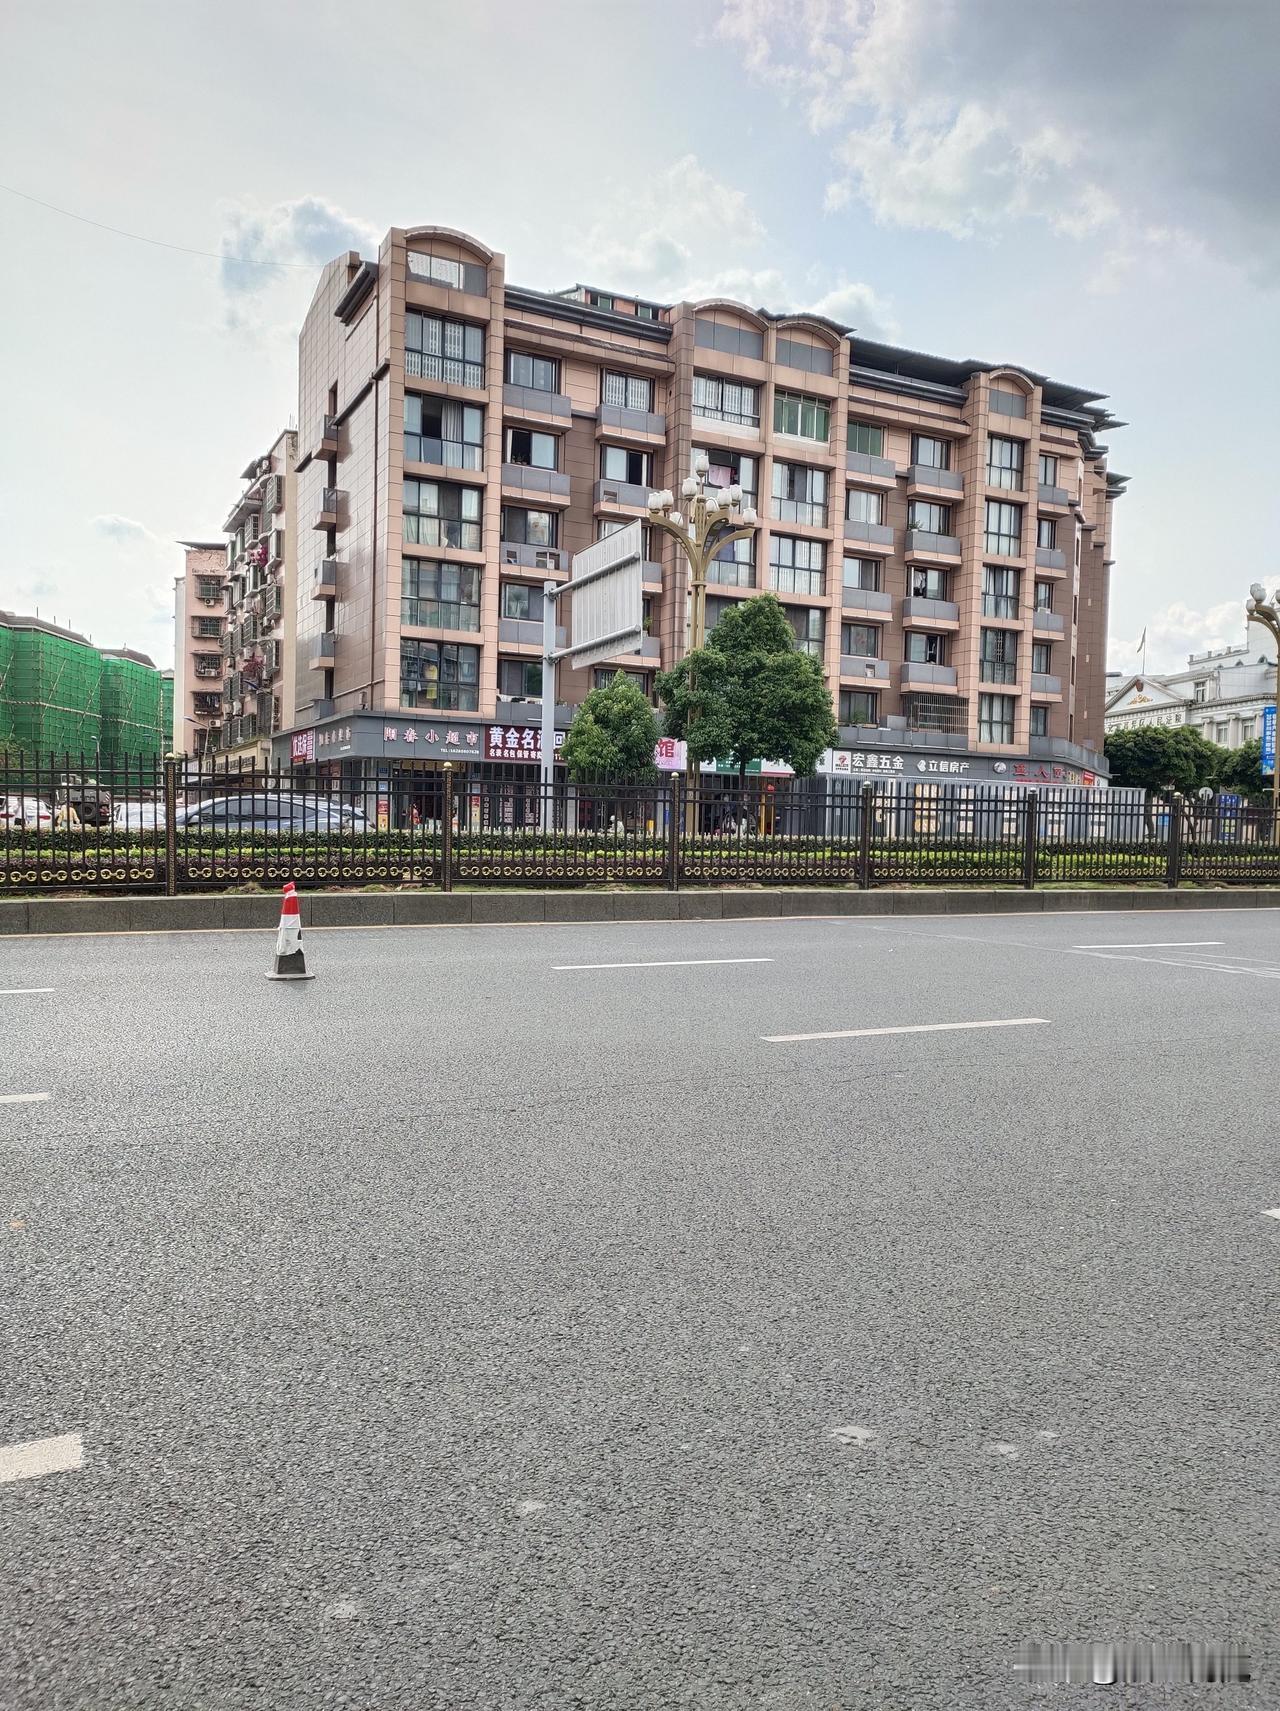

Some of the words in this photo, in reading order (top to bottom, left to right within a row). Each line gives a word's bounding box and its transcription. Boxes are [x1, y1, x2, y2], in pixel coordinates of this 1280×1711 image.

[384, 726, 479, 746] 阳春小超市
[656, 738, 675, 758] 馆
[851, 752, 905, 770] 宏鑫五金
[928, 760, 970, 774] 立信房产
